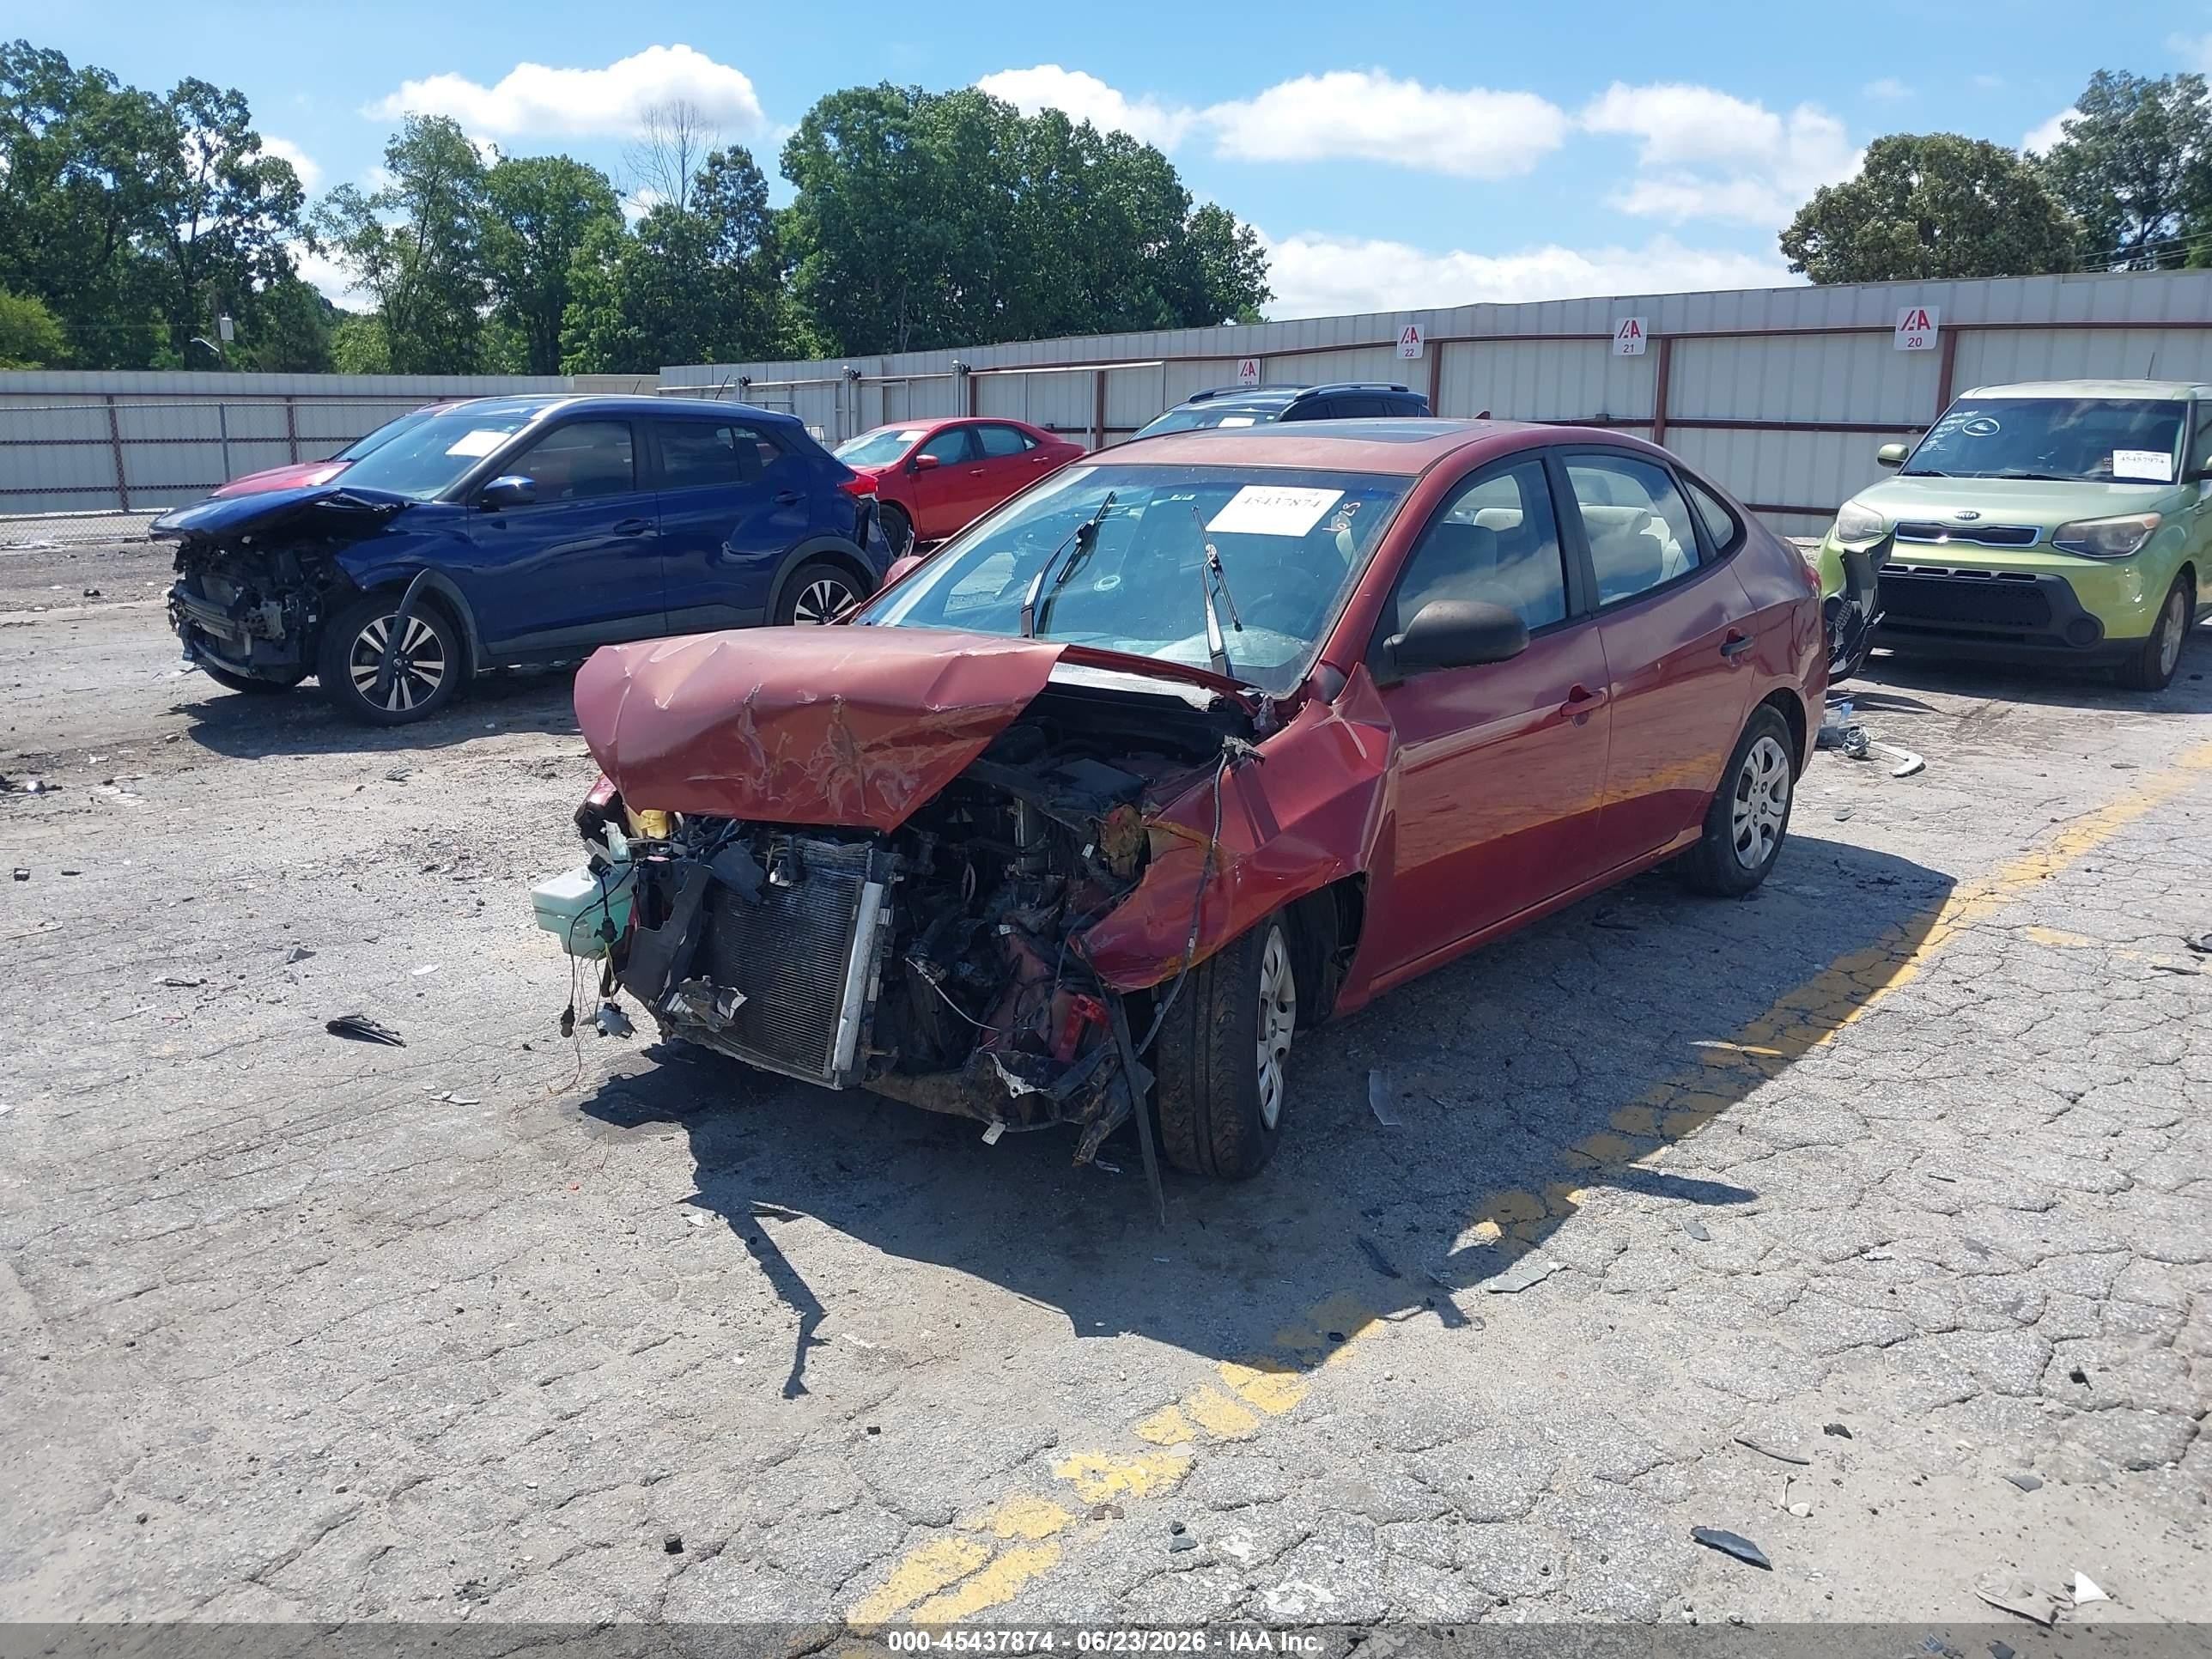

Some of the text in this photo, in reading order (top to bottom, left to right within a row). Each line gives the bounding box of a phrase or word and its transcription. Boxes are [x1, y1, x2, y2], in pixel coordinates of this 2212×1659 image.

[1907, 337, 1923, 347] 20
[1405, 349, 1414, 357] 22
[1623, 343, 1634, 353] 21
